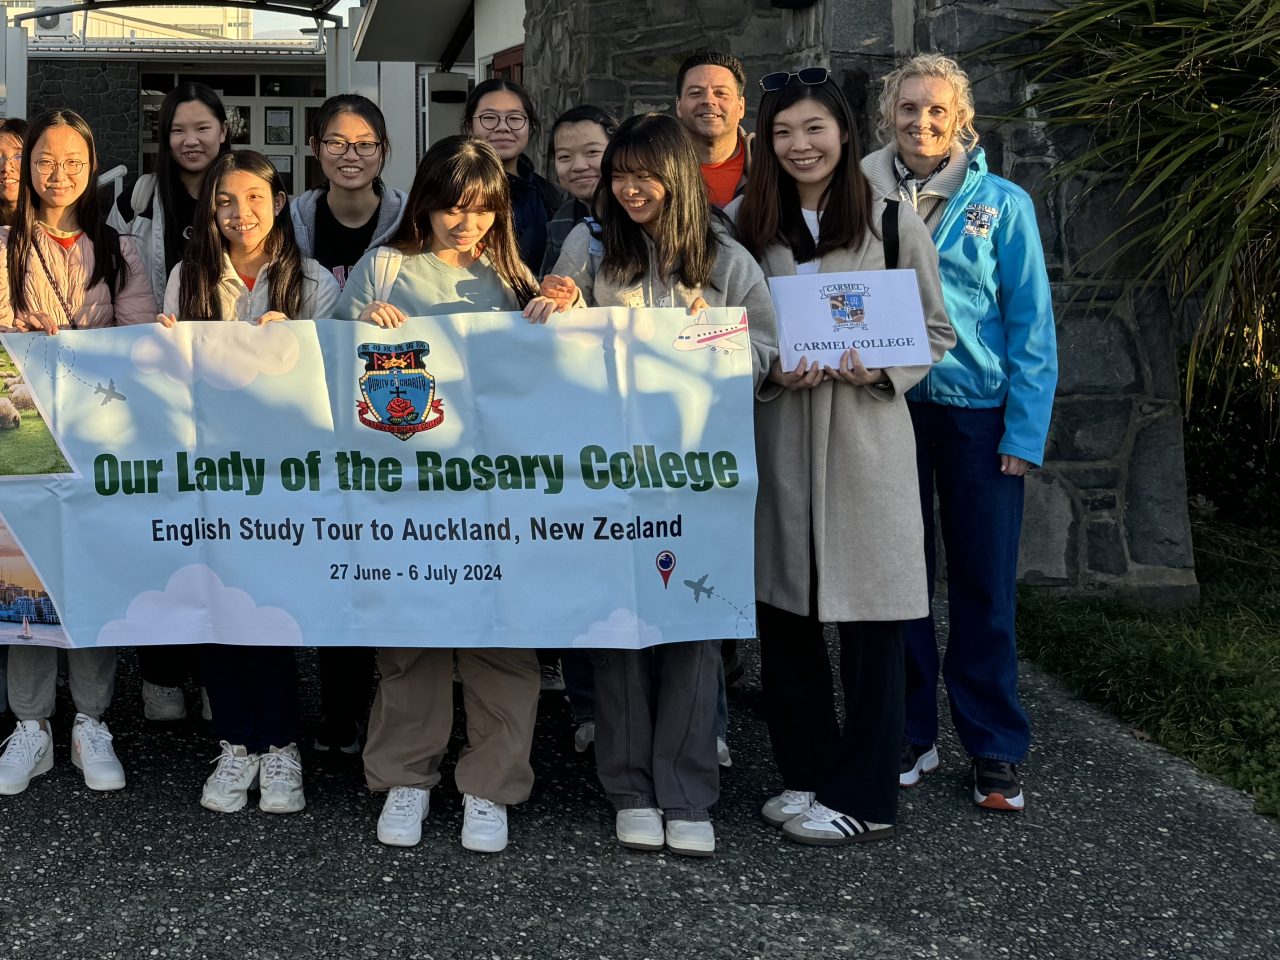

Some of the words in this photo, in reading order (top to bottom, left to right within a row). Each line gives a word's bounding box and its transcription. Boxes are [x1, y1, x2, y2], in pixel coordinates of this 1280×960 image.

[826, 283, 863, 292] CARMEL
[794, 340, 850, 352] CARMEL
[852, 337, 915, 350] COLLEGE
[93, 453, 163, 496] Our
[176, 451, 265, 495] Lady
[280, 451, 321, 491] of
[335, 450, 402, 491] the
[416, 451, 563, 494] Rosary
[579, 445, 739, 492] College
[151, 517, 231, 546] English
[239, 517, 304, 546] Study
[312, 517, 363, 540] Tour
[370, 520, 393, 540] to
[402, 517, 520, 544] Auckland,
[530, 517, 584, 540] New
[592, 514, 682, 540] Zealand
[330, 564, 349, 580] 27
[354, 564, 391, 580] June
[408, 564, 419, 581] 6
[424, 564, 458, 585] July
[463, 564, 502, 581] 2024
